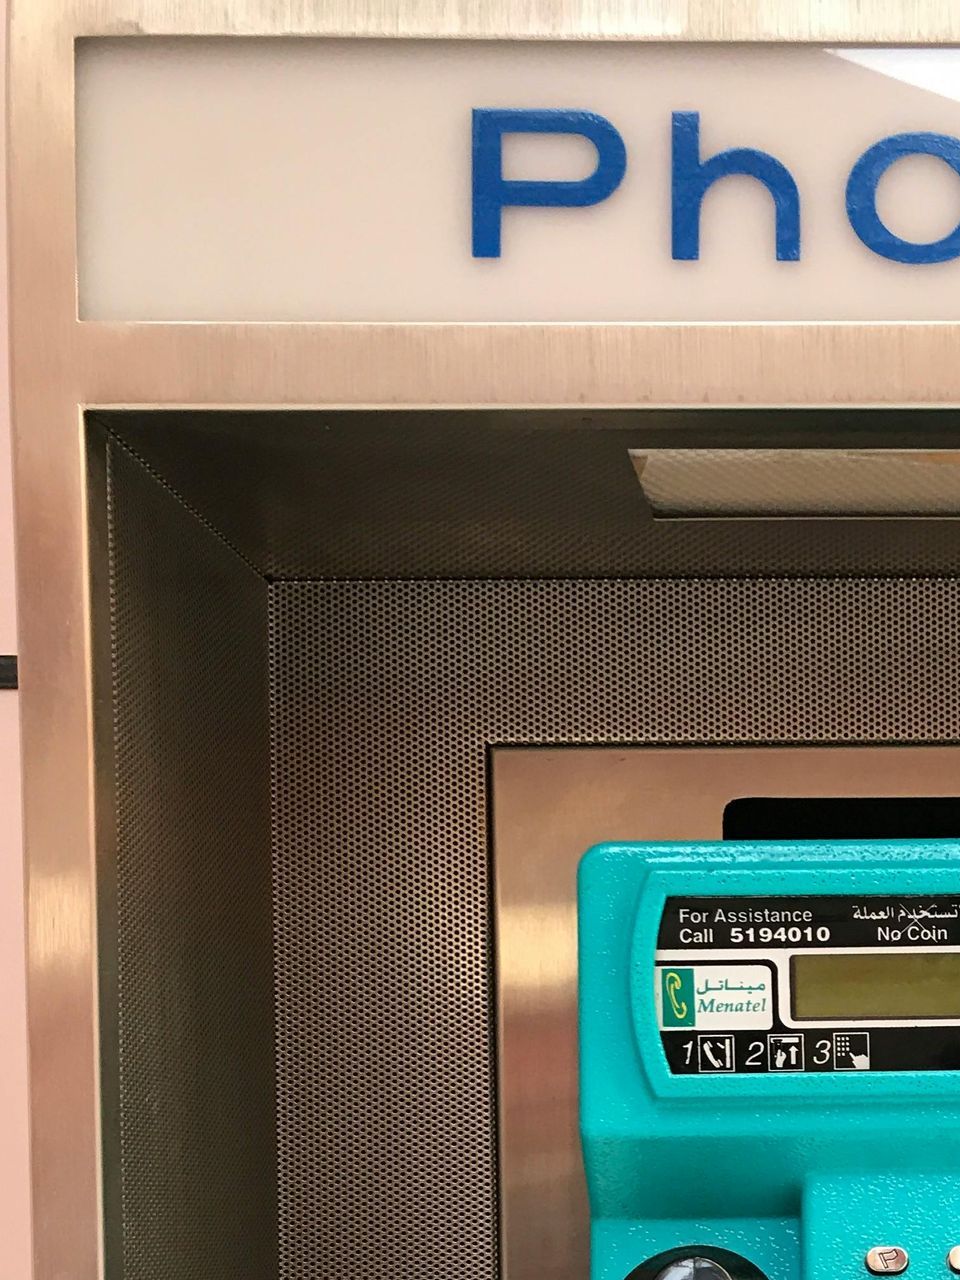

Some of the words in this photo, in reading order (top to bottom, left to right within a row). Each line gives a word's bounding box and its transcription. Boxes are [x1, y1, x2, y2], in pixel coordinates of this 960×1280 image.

[679, 908, 709, 923] For
[713, 908, 813, 923] Assistance
[851, 905, 895, 920] العملة
[679, 928, 714, 943] Call
[730, 926, 831, 943] 5194010
[877, 926, 902, 941] No
[906, 925, 948, 941] Coin
[696, 979, 766, 995] ميناتل
[697, 998, 767, 1013] Menatel
[682, 1040, 694, 1065] 1
[744, 1041, 765, 1066] 2
[812, 1039, 832, 1065] 3
